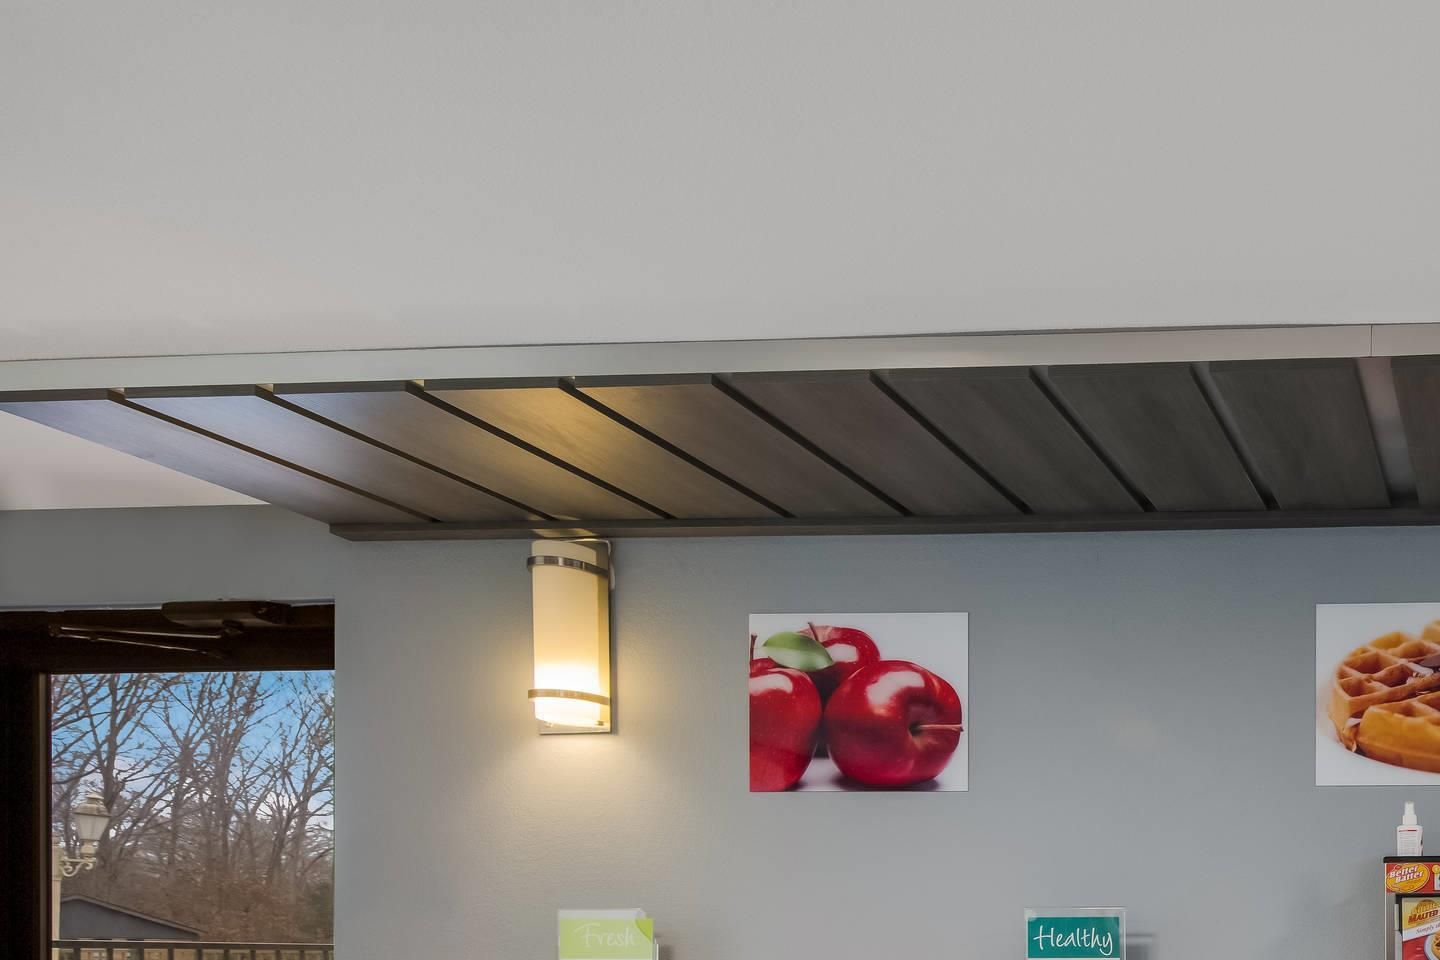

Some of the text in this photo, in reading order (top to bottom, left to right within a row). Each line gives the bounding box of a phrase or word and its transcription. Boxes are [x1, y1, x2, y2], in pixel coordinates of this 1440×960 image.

[1390, 865, 1419, 878] Better
[1395, 870, 1424, 883] Batter
[1408, 909, 1439, 924] MALTED
[573, 922, 637, 948] Fresh
[1416, 924, 1434, 934] Simply
[1033, 924, 1113, 956] Healthy
